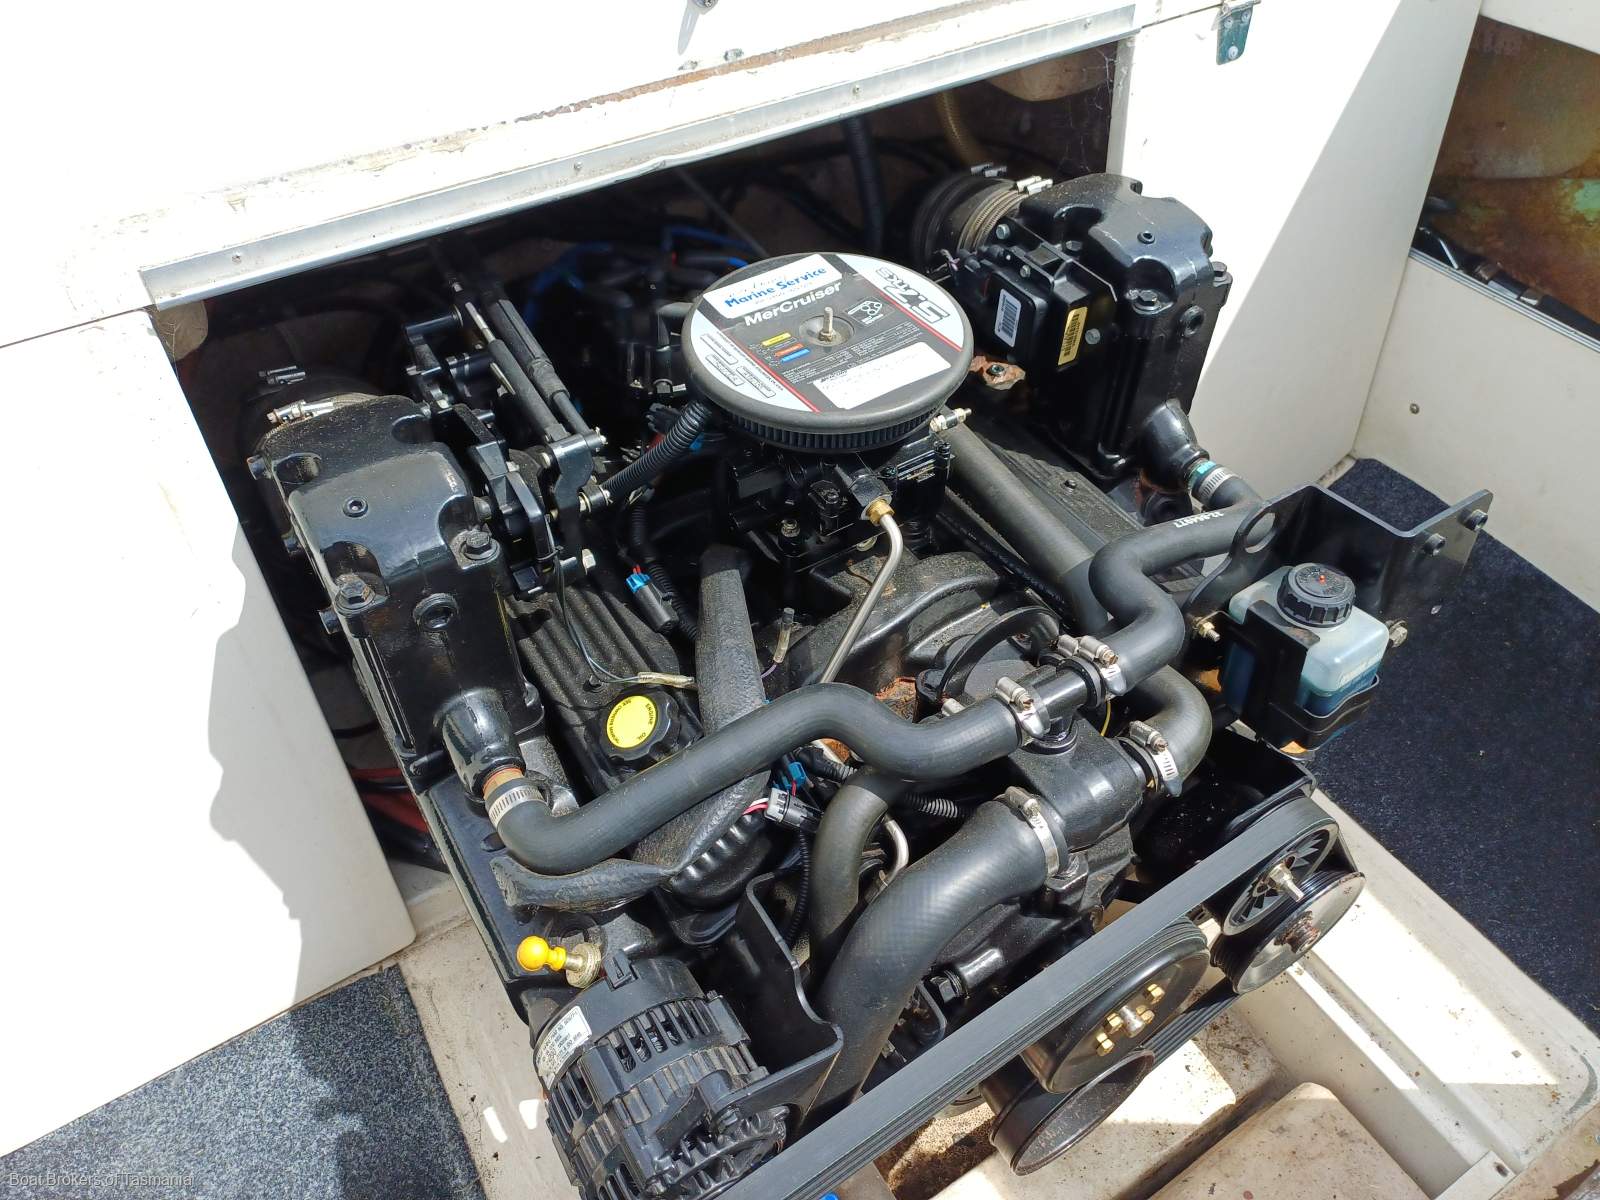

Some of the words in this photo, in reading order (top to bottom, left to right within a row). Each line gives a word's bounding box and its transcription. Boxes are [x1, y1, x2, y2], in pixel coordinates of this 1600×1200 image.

[724, 286, 776, 308] Marine
[775, 266, 827, 291] Service
[743, 281, 842, 326] MerCruiser
[883, 285, 951, 324] 5.7
[645, 703, 655, 725] ENGINE
